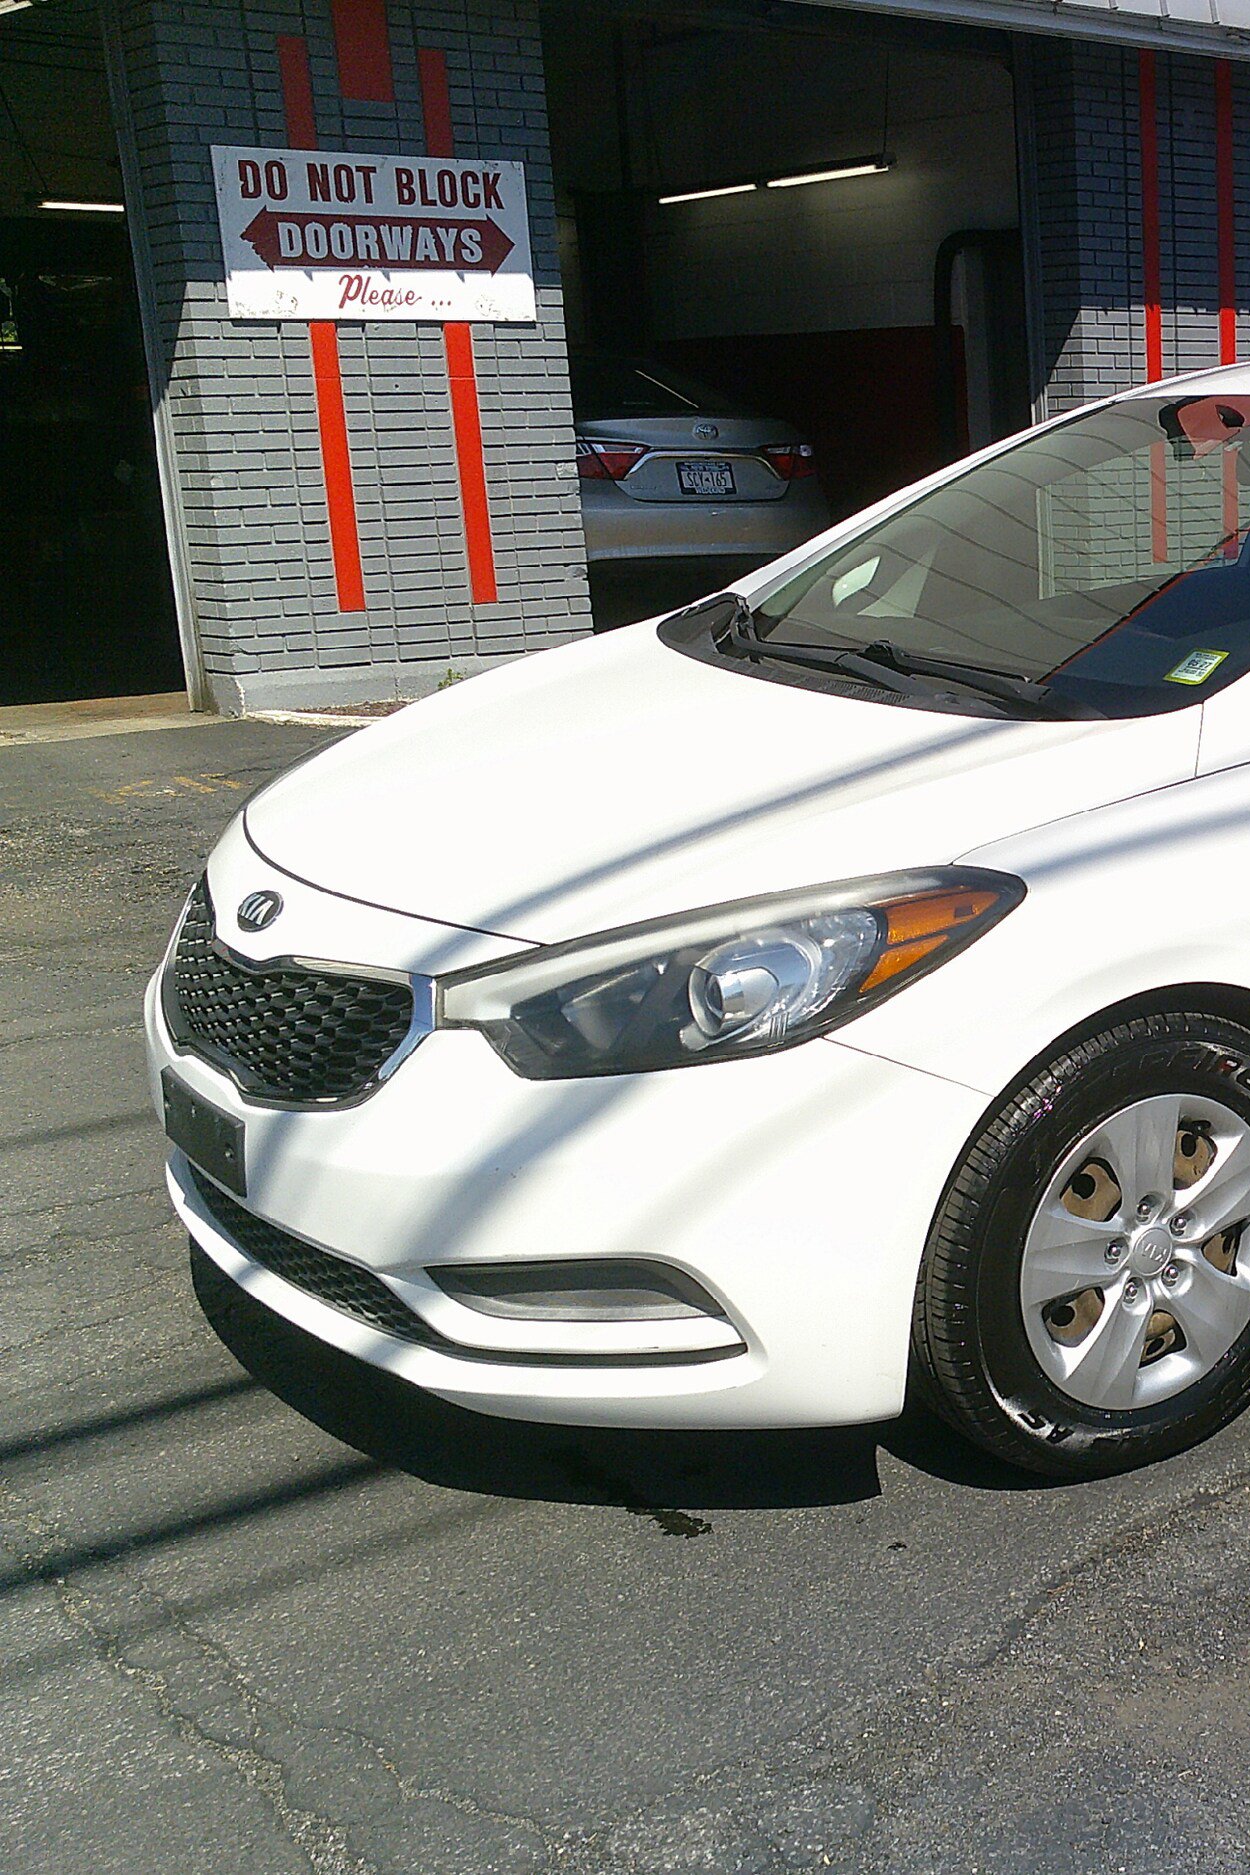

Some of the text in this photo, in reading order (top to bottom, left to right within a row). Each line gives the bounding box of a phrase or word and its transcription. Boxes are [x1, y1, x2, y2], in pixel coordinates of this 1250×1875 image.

[238, 159, 506, 210] DO NOT BLOCK
[277, 221, 483, 263] DOORWAYS
[238, 892, 274, 925] KIA
